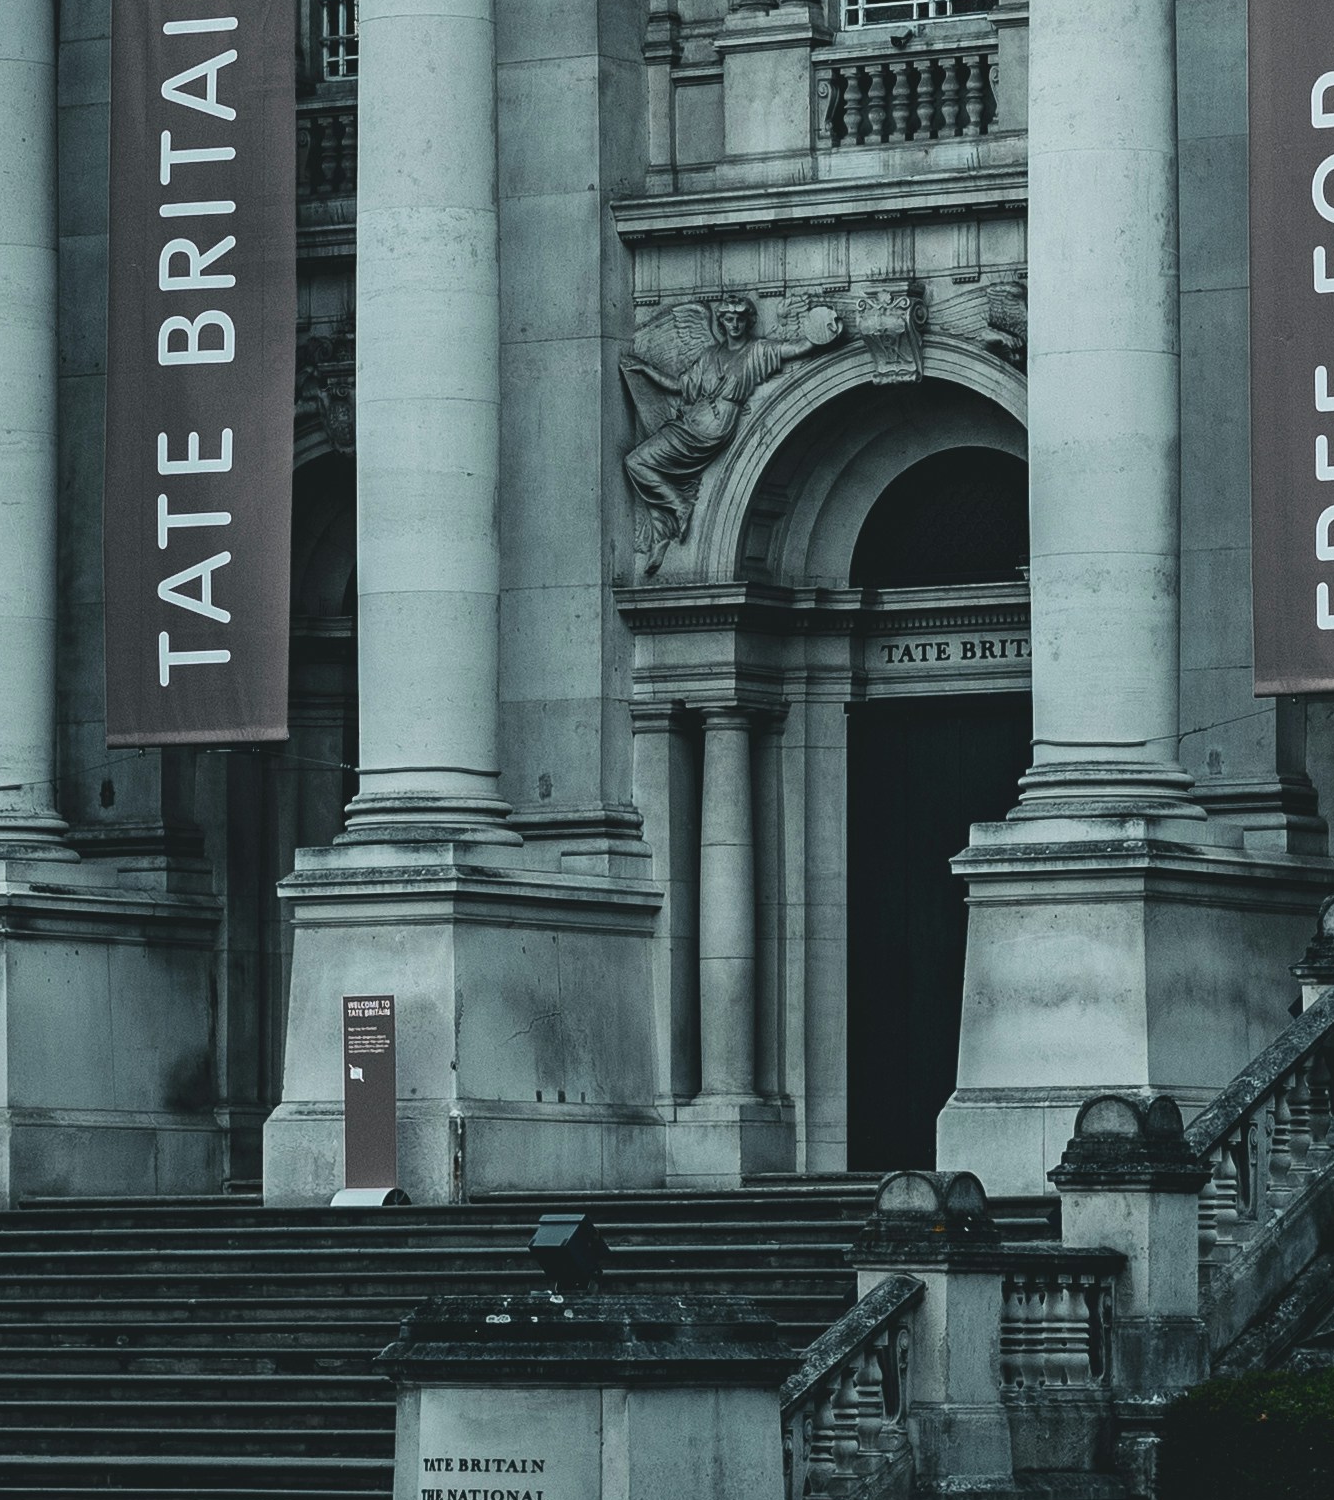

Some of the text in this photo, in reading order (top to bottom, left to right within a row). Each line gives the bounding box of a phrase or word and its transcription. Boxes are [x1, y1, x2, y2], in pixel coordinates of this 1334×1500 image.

[157, 427, 234, 688] TATE
[881, 638, 1032, 664] TATE BRIT
[347, 1000, 391, 1009] WELCOME TO
[347, 1009, 363, 1017] TATE
[423, 1457, 546, 1474] TATE BRITAIN
